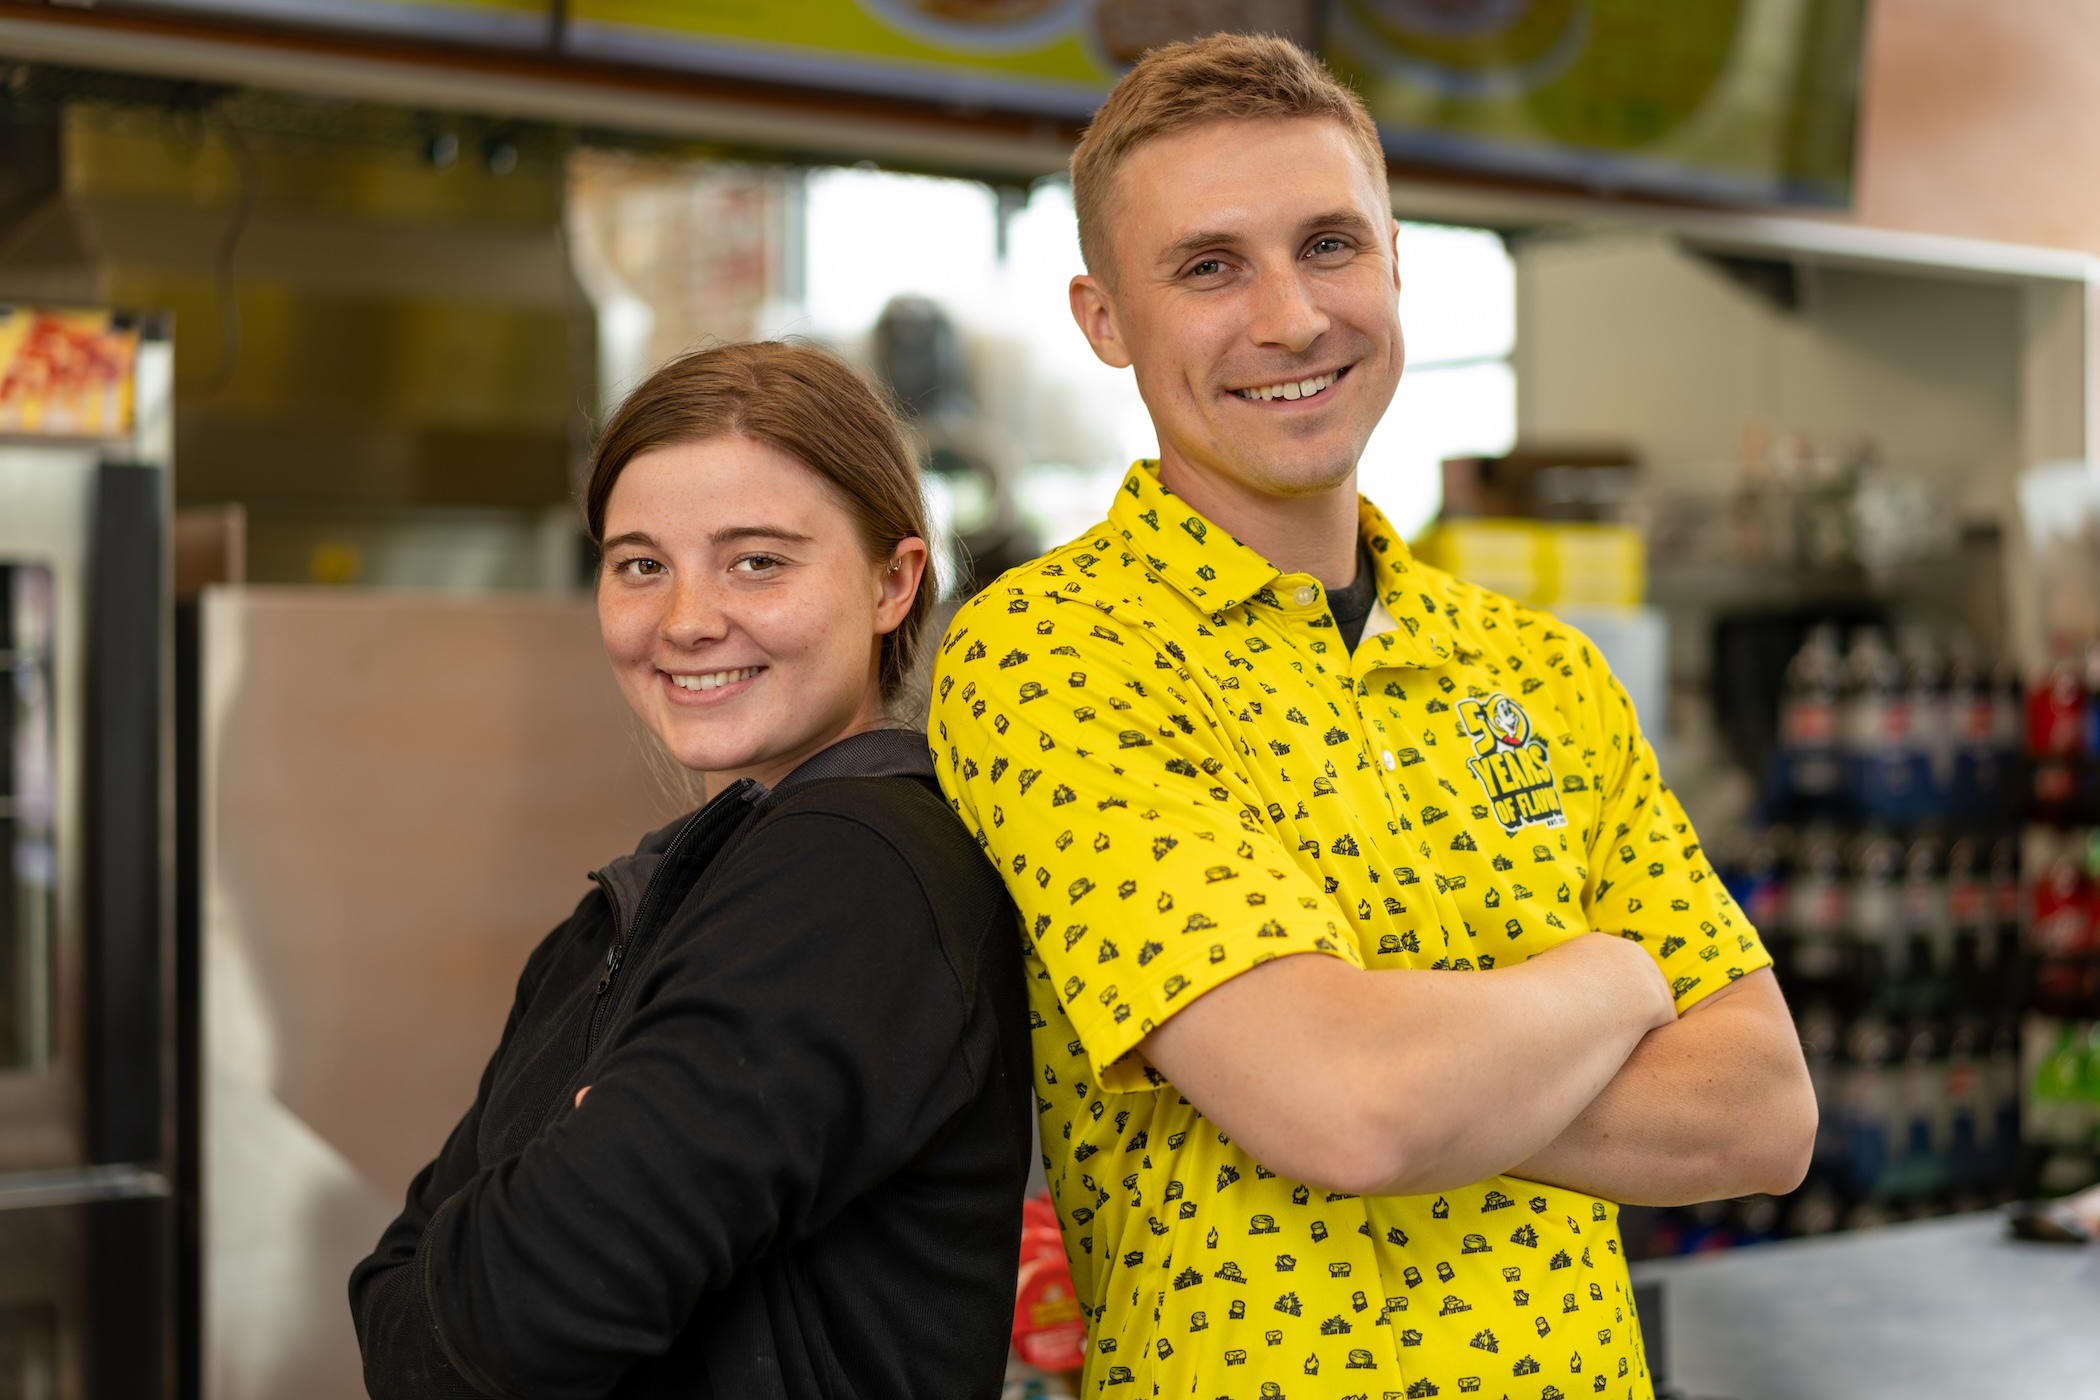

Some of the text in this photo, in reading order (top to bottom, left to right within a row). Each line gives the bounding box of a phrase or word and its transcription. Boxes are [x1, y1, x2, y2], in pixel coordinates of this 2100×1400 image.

[1471, 744, 1553, 798] YEARS
[1493, 797, 1520, 826] OF
[1331, 847, 1347, 855] GARLIC
[1072, 1048, 1086, 1057] BUTTE
[1481, 1199, 1515, 1213] BUTTER CHEESE
[1214, 1271, 1231, 1281] BUTTER
[1331, 1270, 1350, 1278] BUTTER
[1389, 1304, 1407, 1312] BUTTER
[1439, 1303, 1472, 1317] BUTTER CHEESE
[1226, 1358, 1246, 1366] BUTTER
[1407, 1390, 1426, 1399] ITALIAN
